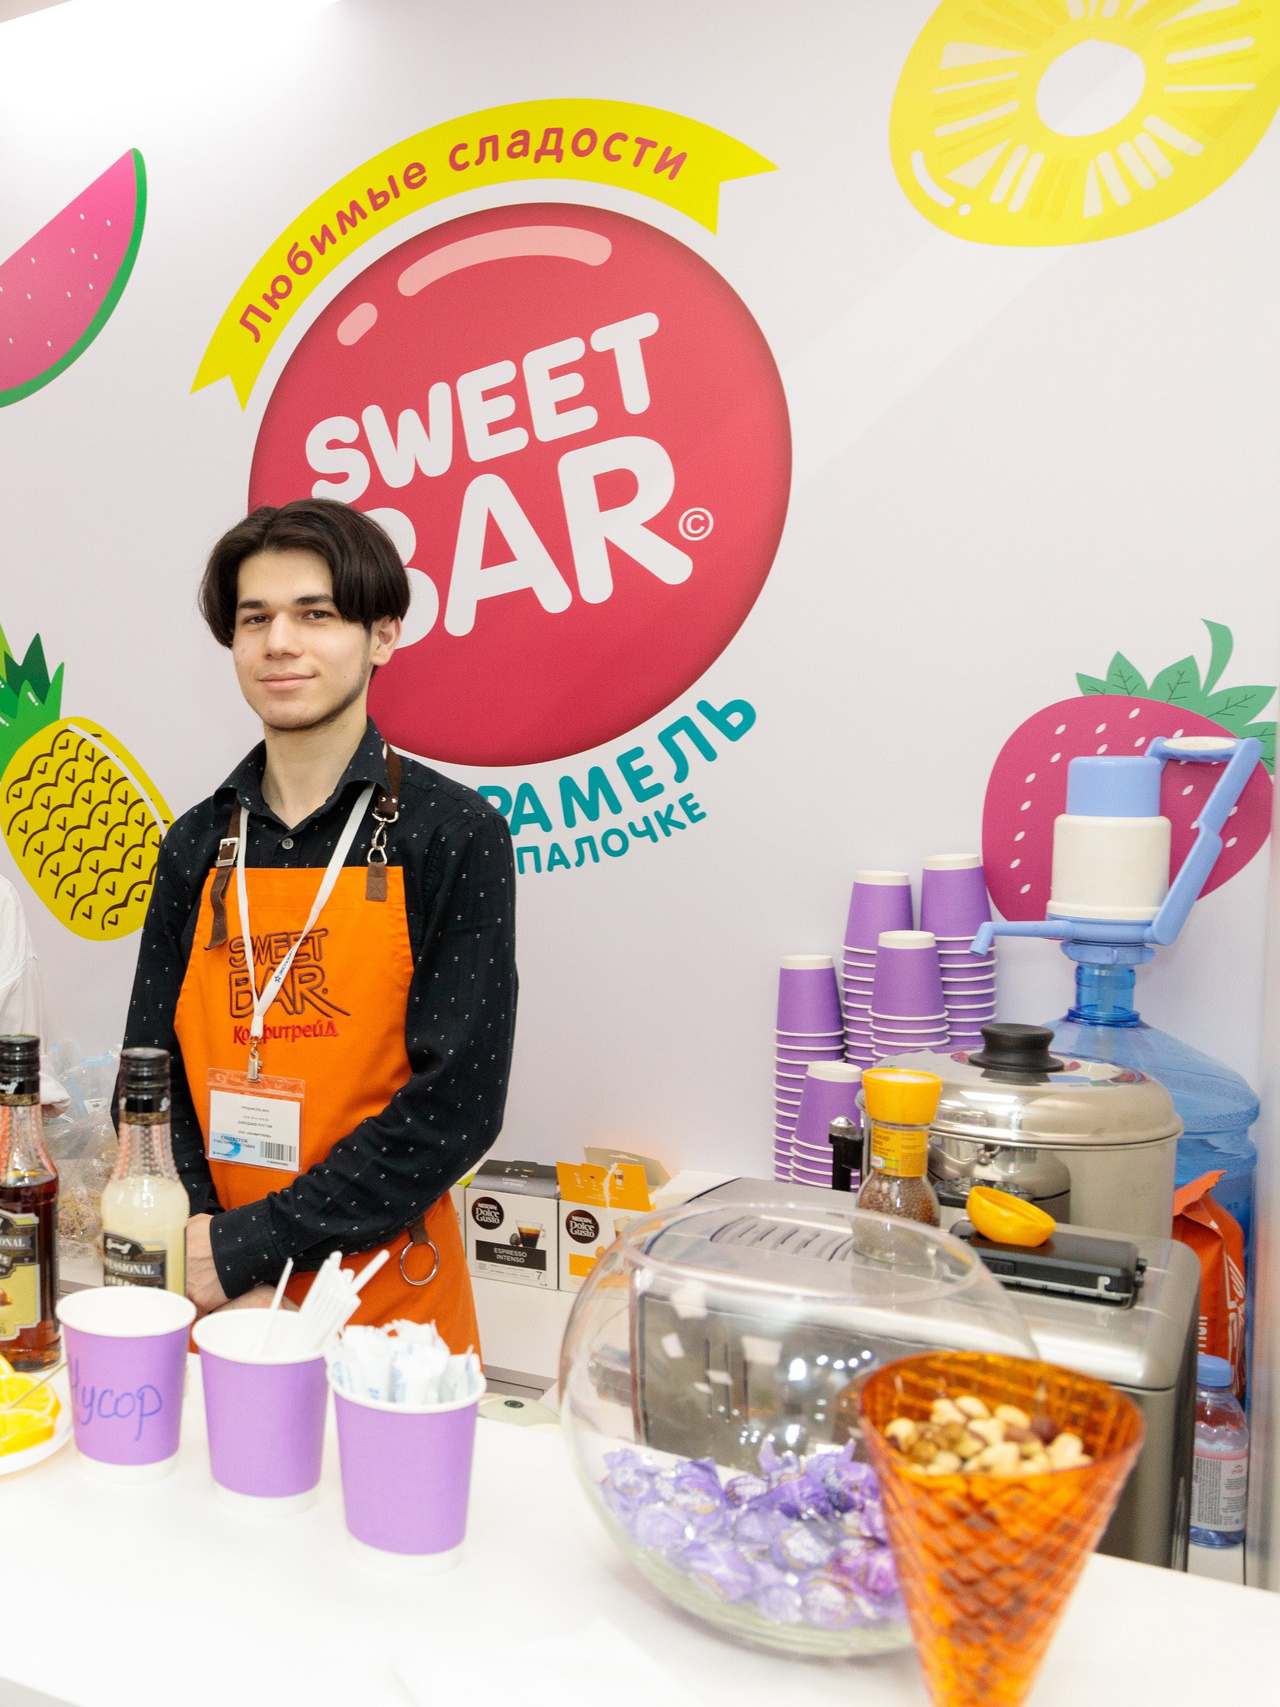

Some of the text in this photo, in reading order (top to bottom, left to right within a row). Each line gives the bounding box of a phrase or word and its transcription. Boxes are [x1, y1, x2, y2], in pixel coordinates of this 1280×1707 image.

[238, 126, 688, 343] Любимые сладости
[305, 312, 659, 506] SWEET
[517, 792, 708, 874] ПАЛОЧКЕ
[229, 928, 329, 968] SWEET
[233, 1019, 340, 1046] Кофитрейд
[475, 1207, 500, 1218] Dolce
[475, 1214, 500, 1224] Gusto
[570, 1220, 595, 1232] Dolce
[570, 1227, 595, 1238] Gusto
[493, 1247, 527, 1258] ESPRESSO
[496, 1254, 525, 1264] INTENSO
[536, 1270, 543, 1280] 7
